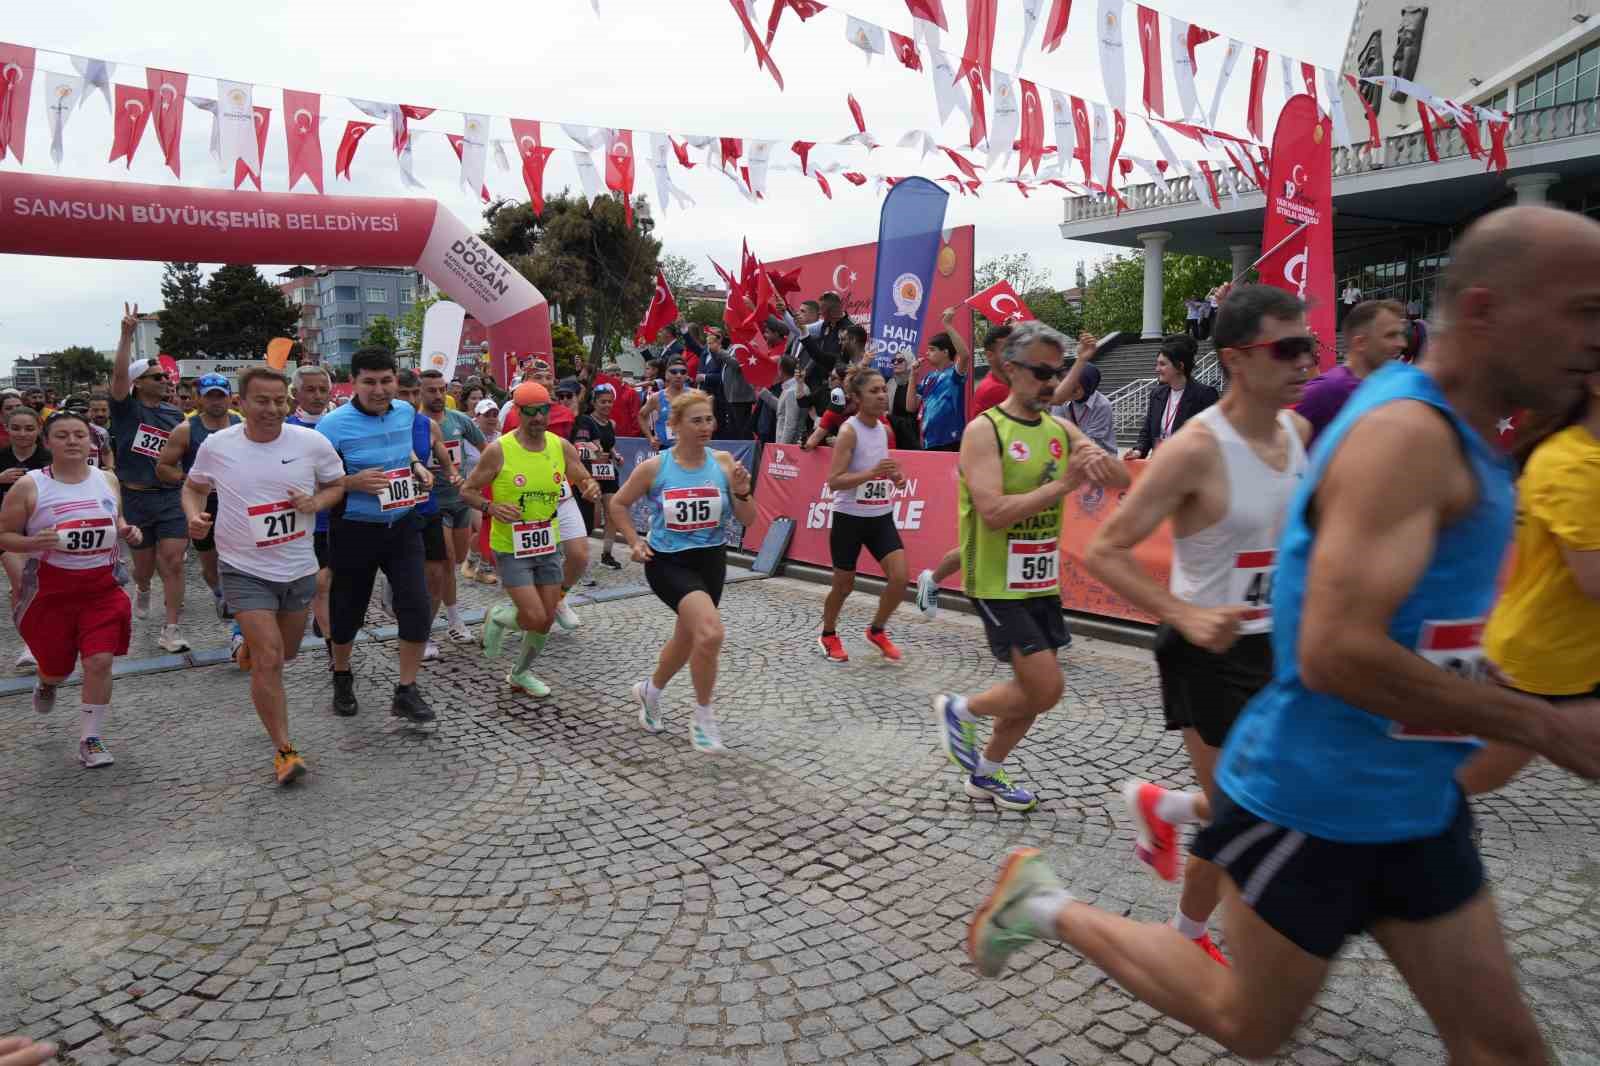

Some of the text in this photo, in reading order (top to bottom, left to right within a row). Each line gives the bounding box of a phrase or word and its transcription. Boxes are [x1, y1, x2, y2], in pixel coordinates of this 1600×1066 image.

[13, 197, 400, 232] SAMSUN BÜYÜKŞEHİR BELEDİYESİ
[451, 240, 509, 295] DOĞAN
[878, 340, 912, 354] DOĞA
[388, 480, 409, 500] 108
[864, 482, 887, 499] 346
[675, 500, 711, 523] 315
[264, 511, 296, 537] 217
[66, 529, 106, 550] 397
[521, 529, 550, 549] 590
[1022, 556, 1054, 580] 591
